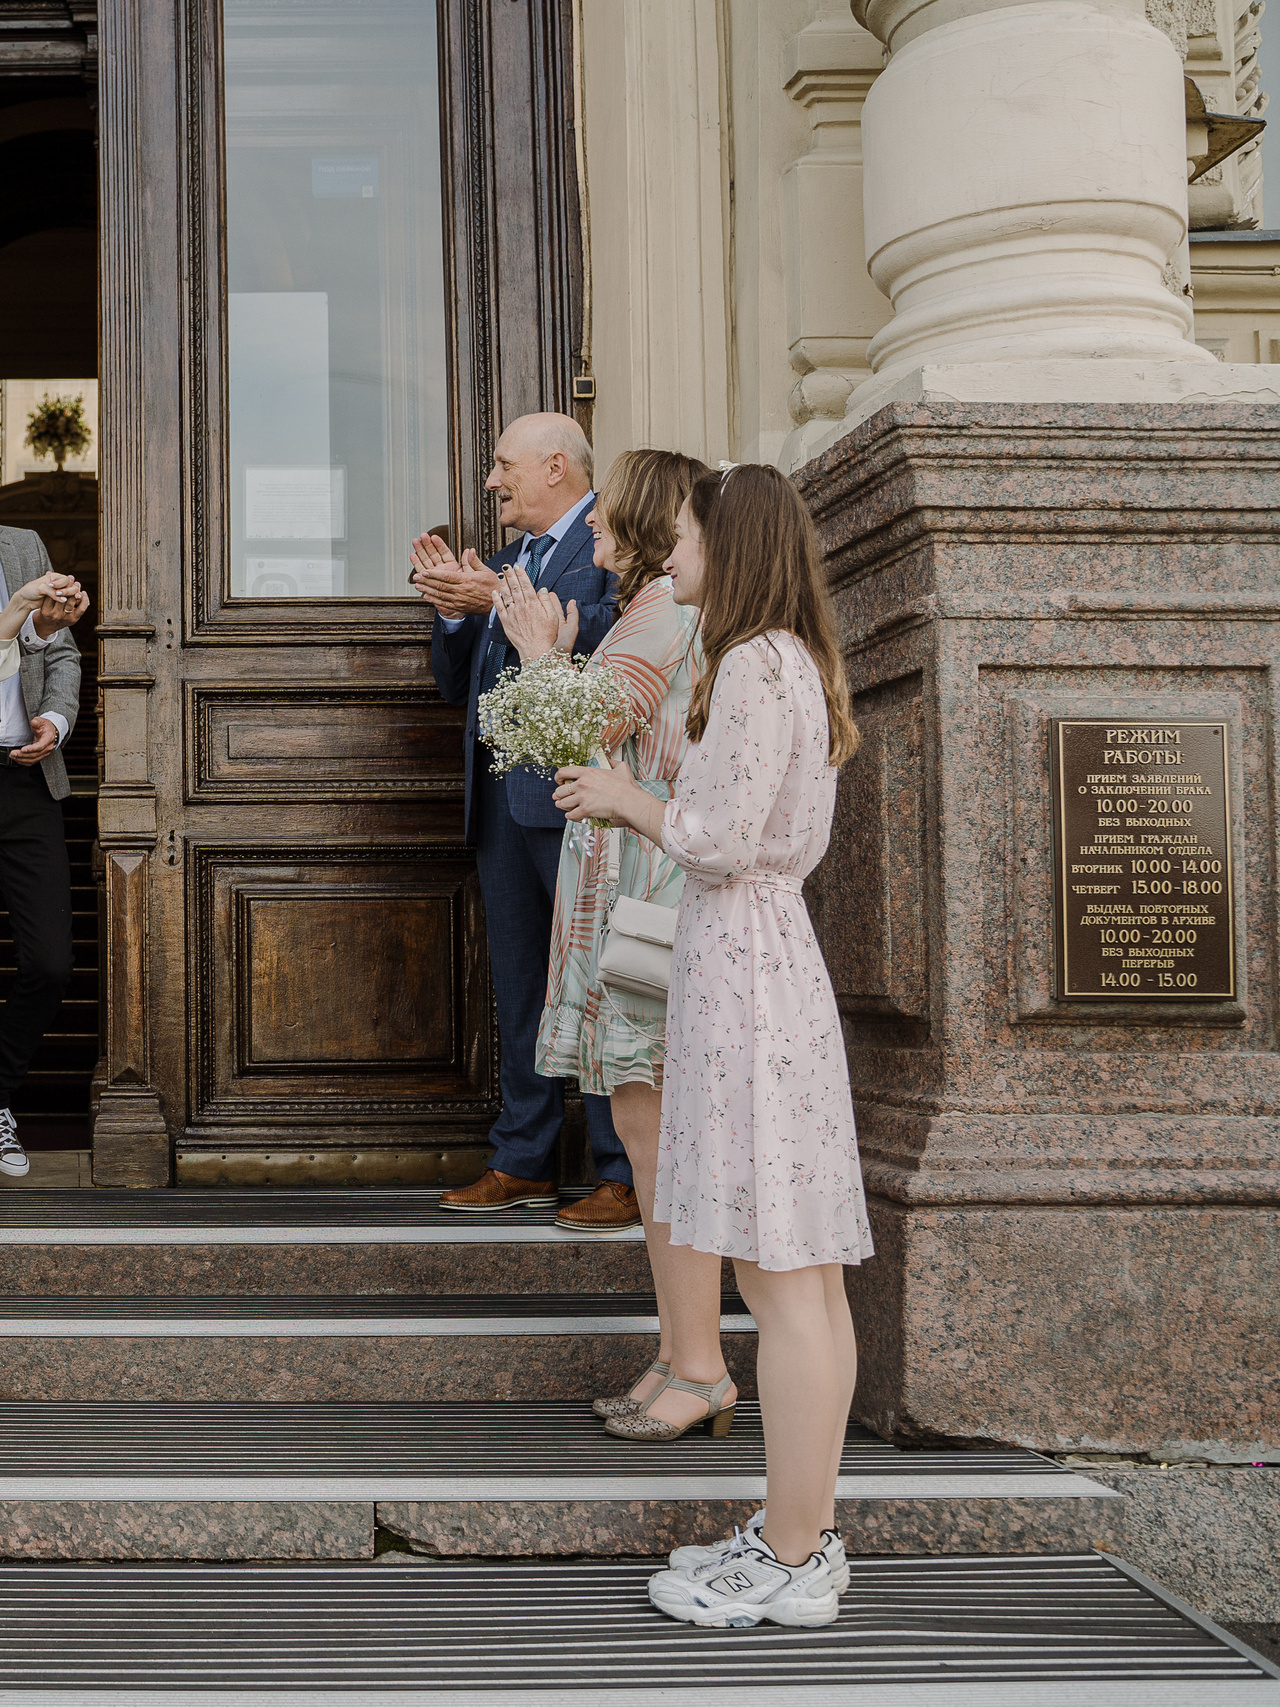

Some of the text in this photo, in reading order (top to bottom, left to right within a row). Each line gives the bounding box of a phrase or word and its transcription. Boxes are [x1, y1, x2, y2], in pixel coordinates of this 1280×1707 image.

[1106, 729, 1181, 744] РЕЖИМ
[1103, 751, 1185, 764] РАБОТЫ:
[1087, 773, 1201, 783] ПРИЕМ ЗАЯВЛЕНИЙ
[1078, 786, 1211, 795] О ЗАКЛЮЧЕНИИ БРАКА
[1098, 818, 1191, 828] БЕЗ ВЫХОДНЫХ
[1094, 835, 1198, 845] ПРИЕМ ГРАЖДАН
[1080, 846, 1212, 856] НАЧАЛЬНИКОМ ОТДЕЛА
[1071, 864, 1122, 873] ВТОРНИК
[1072, 885, 1121, 894] ЧЕТВЕРГ
[1087, 905, 1208, 914] ВЫДАЧА ПОВТОРНЫХ
[1080, 916, 1216, 926] ДОКУМЕНТОВ В АРХИВЕ
[1102, 948, 1194, 958] БЕЗ ВЫХОДНЫХ
[1122, 959, 1175, 968] ПЕРЕРЫВ
